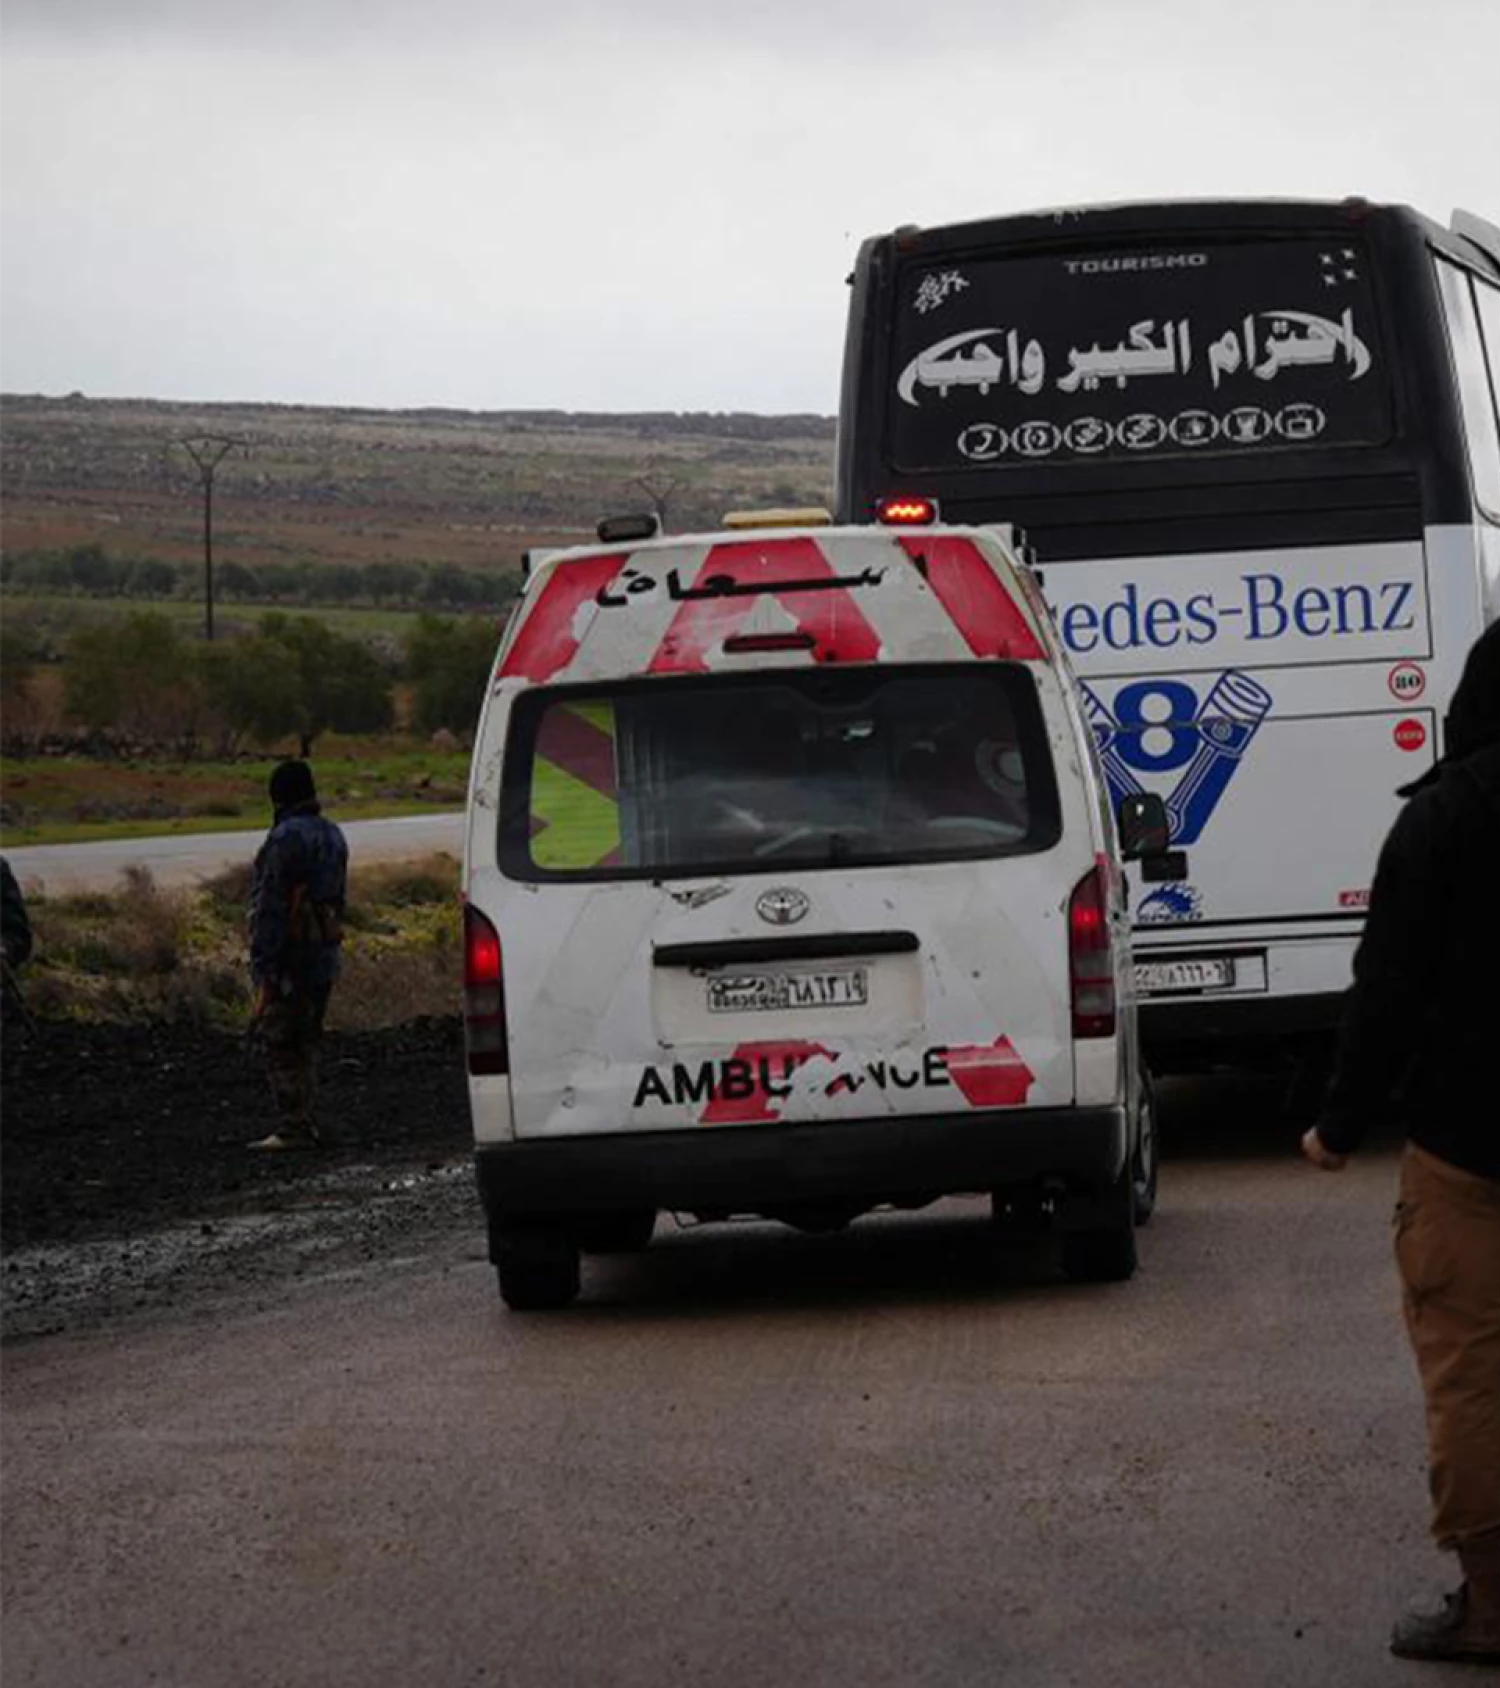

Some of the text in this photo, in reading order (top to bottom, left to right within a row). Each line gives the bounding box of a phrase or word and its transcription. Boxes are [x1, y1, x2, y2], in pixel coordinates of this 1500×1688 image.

[1063, 253, 1208, 274] TOURISMO
[899, 308, 1371, 406] احترام الكبير واجب
[1050, 573, 1415, 653] edes-Benz
